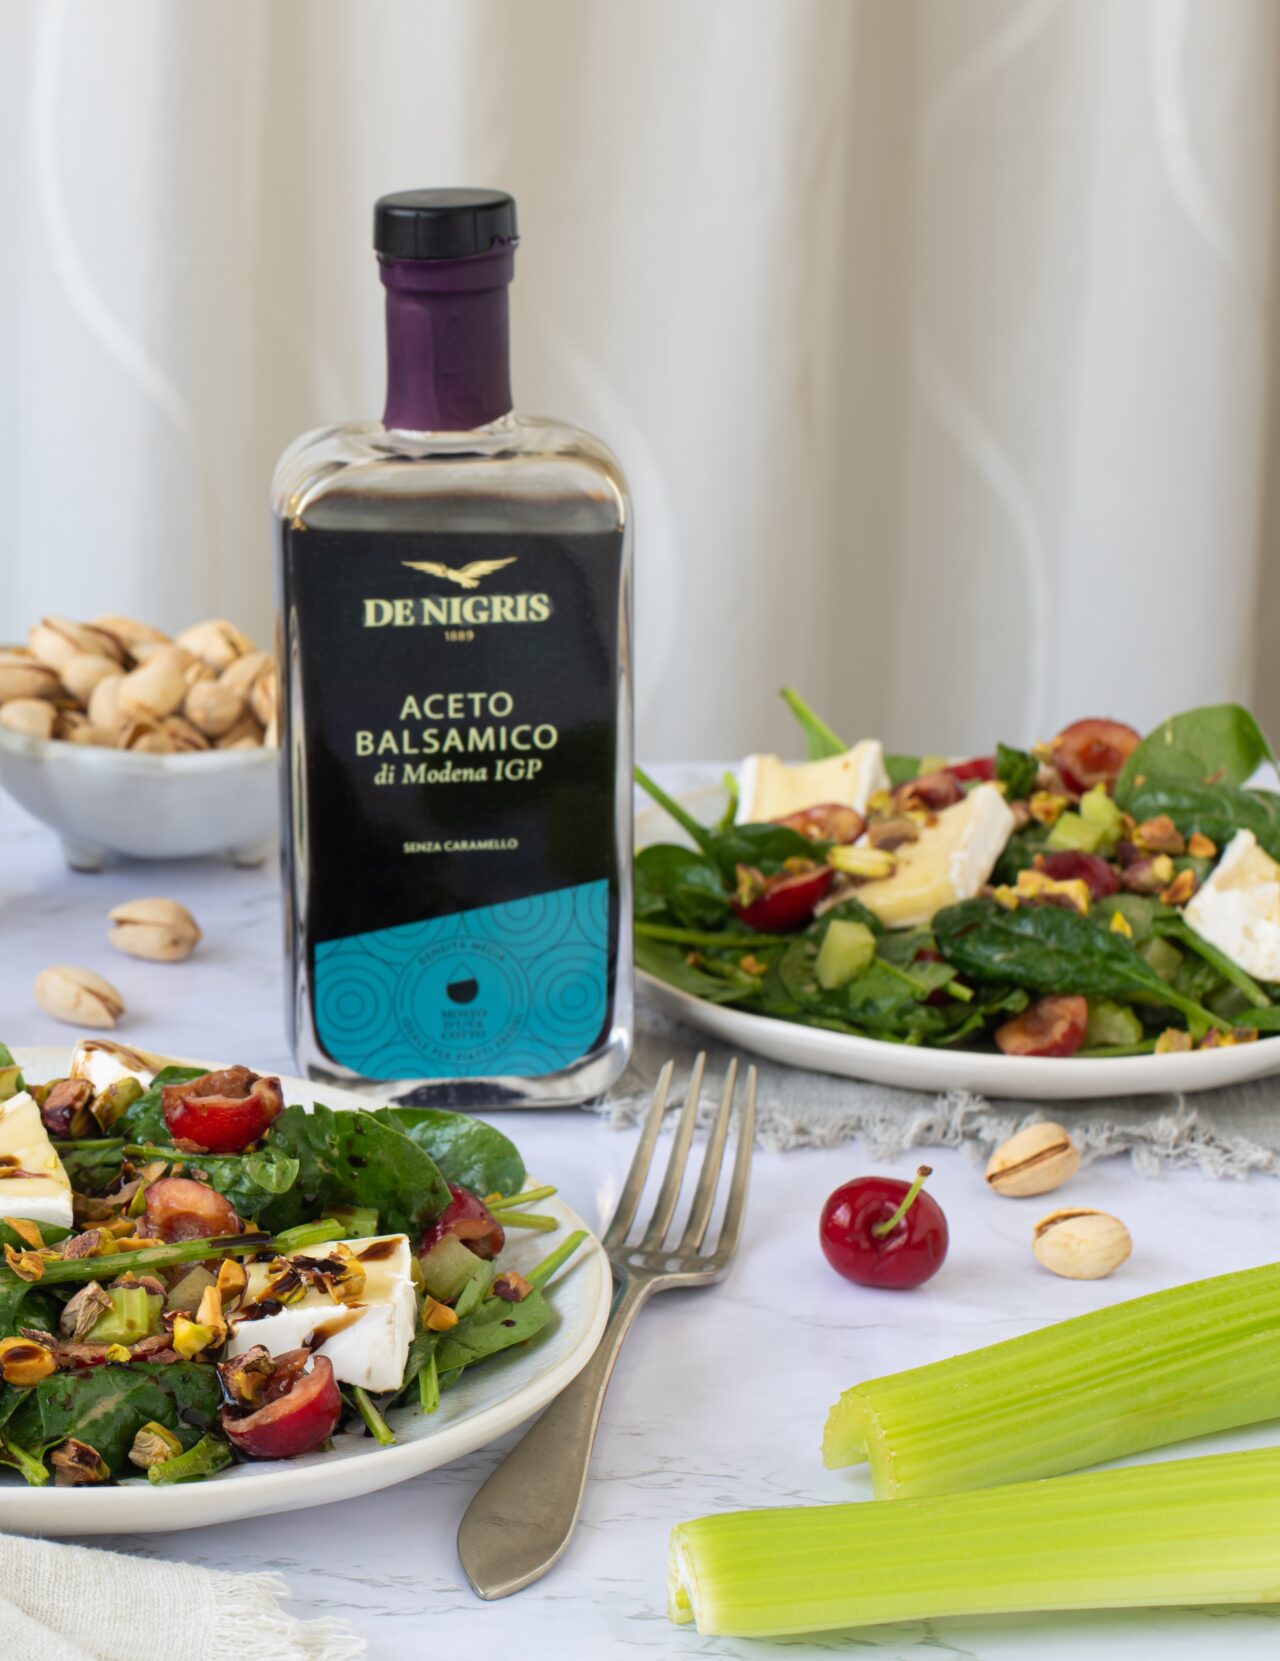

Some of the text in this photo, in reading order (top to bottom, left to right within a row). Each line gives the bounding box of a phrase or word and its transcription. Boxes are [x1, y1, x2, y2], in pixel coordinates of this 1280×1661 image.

[364, 593, 550, 627] DE NIGRIS
[444, 630, 474, 642] 1889
[400, 692, 514, 720] ACETO
[356, 724, 558, 756] BALSAMICO
[374, 759, 542, 785] di Modena IGP
[403, 838, 518, 852] SENZA CARAMELLO
